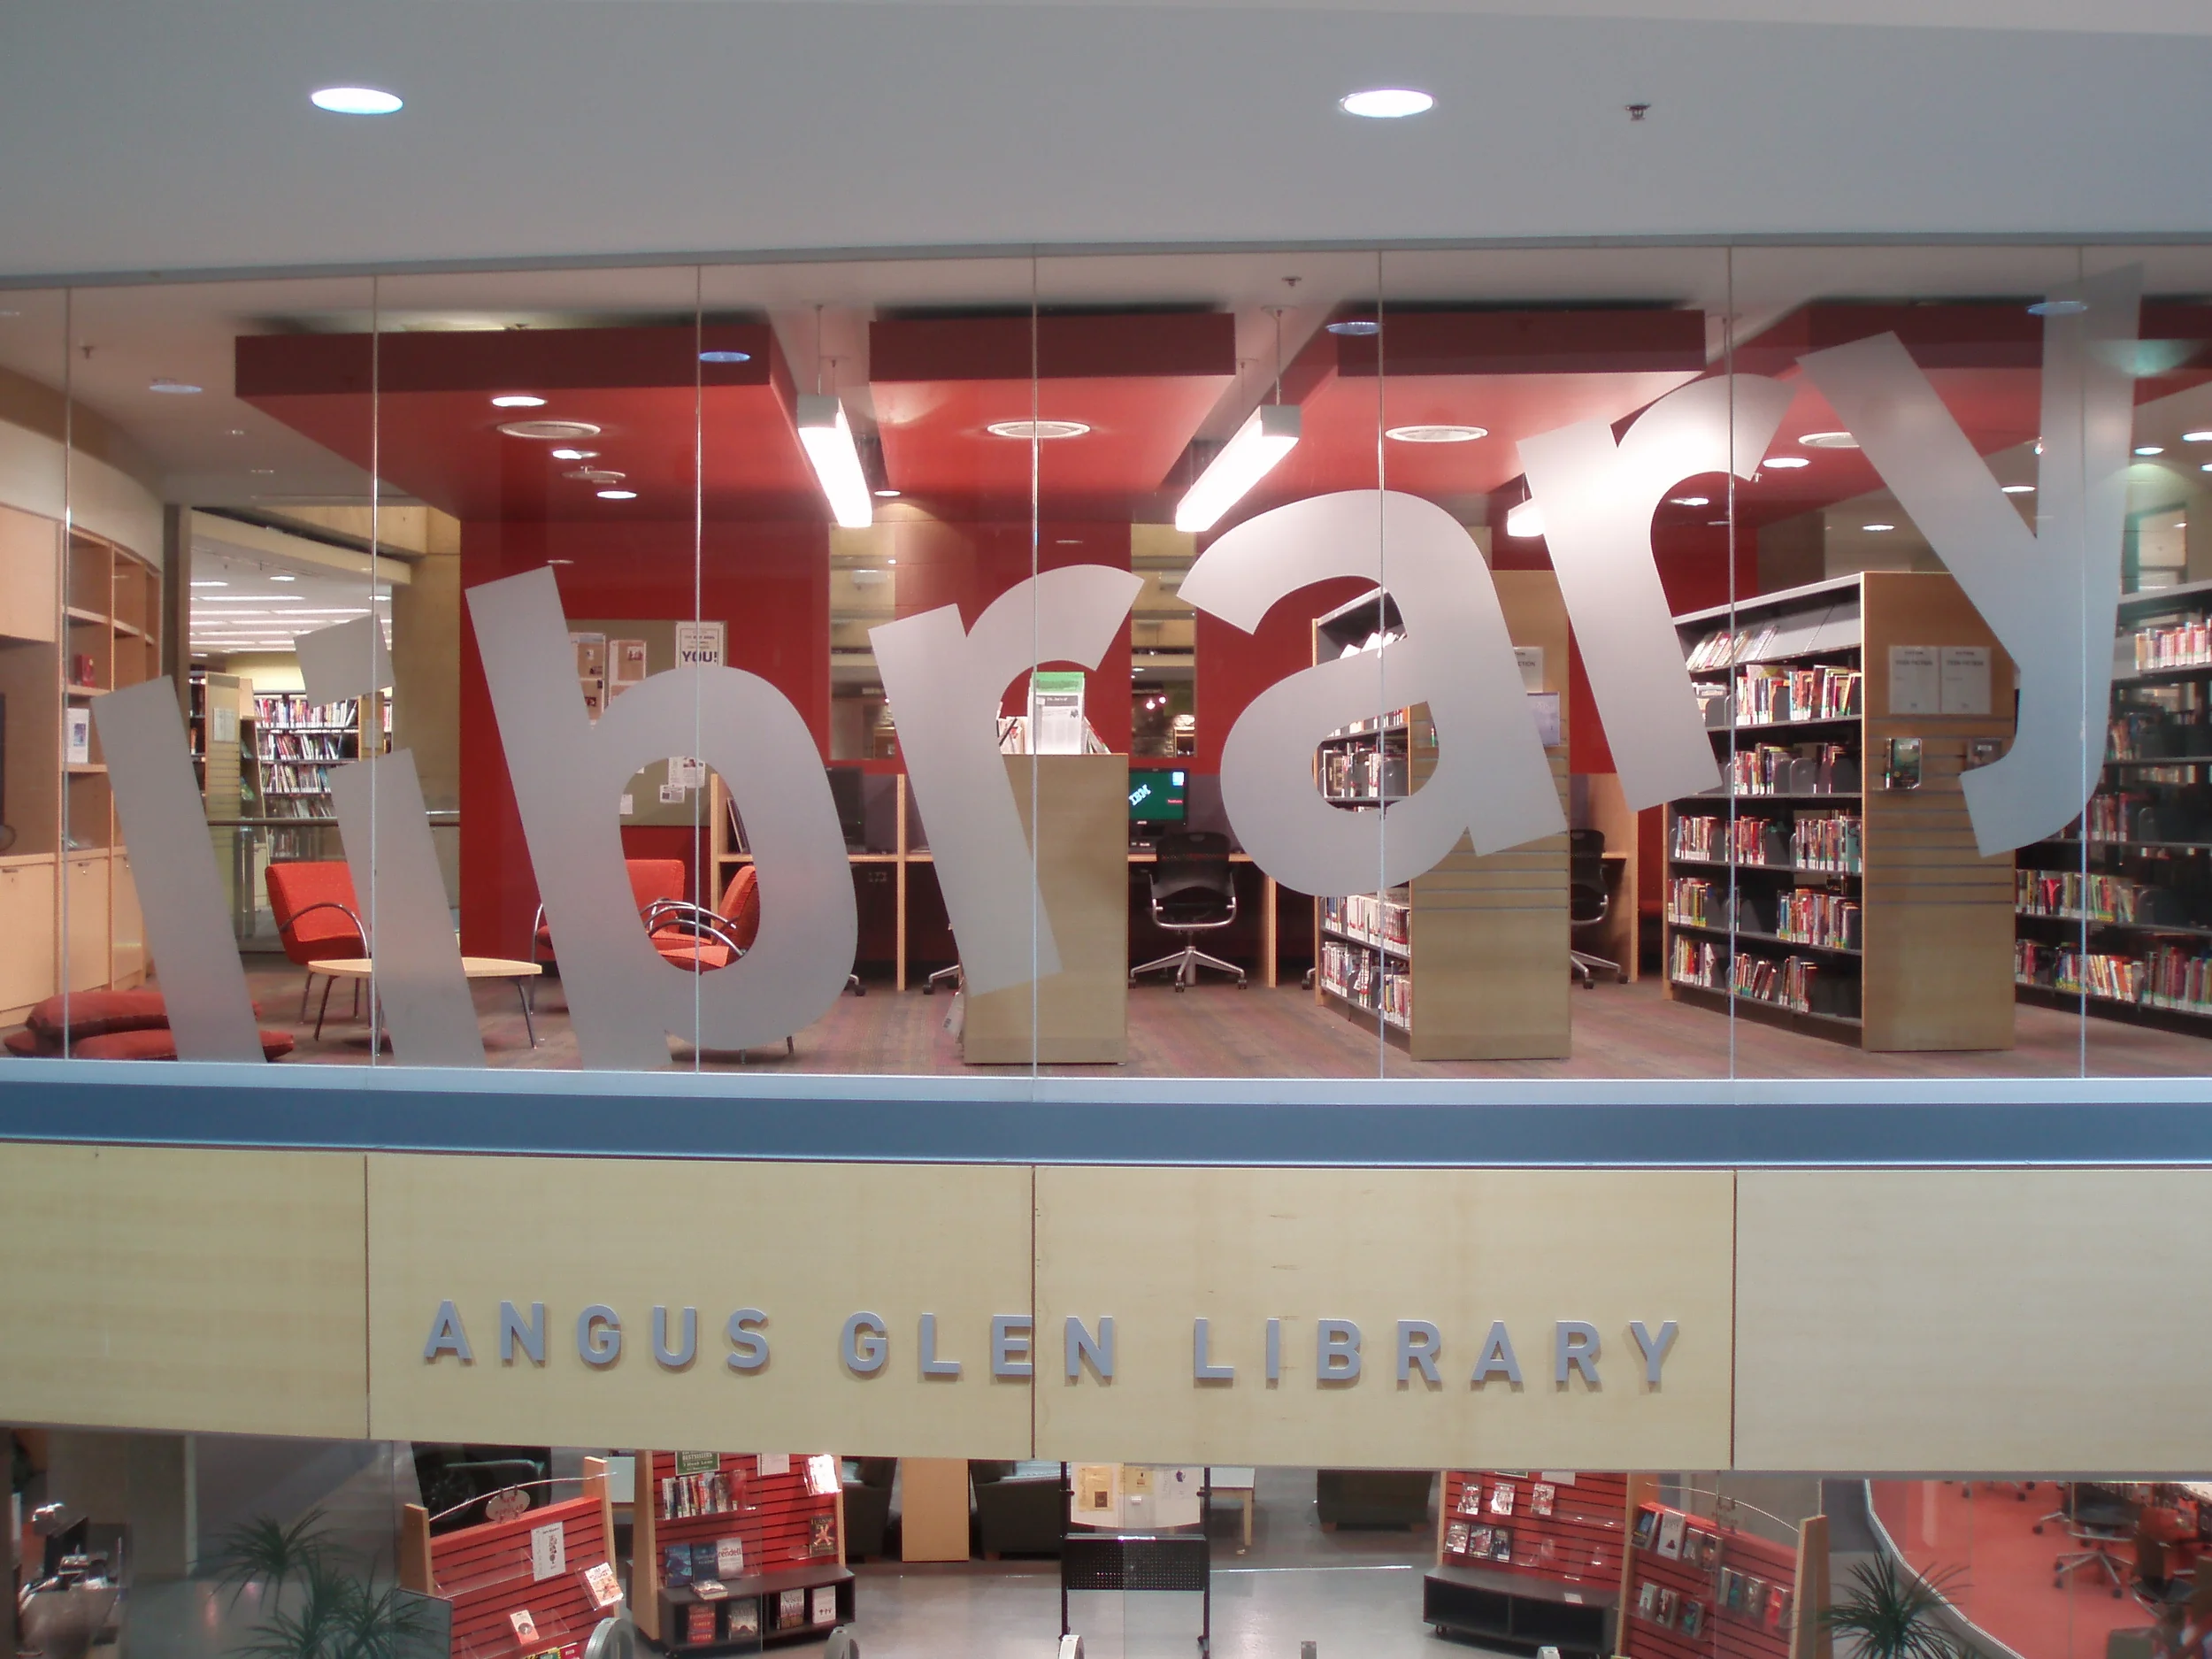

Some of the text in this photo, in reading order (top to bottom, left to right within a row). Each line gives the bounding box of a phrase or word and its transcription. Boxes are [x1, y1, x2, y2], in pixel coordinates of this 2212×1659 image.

[91, 261, 2143, 1071] library
[682, 650, 718, 663] YOU!
[1128, 784, 1151, 806] IBM
[423, 1299, 1678, 1384] ANGUS GLEN LIBRARY
